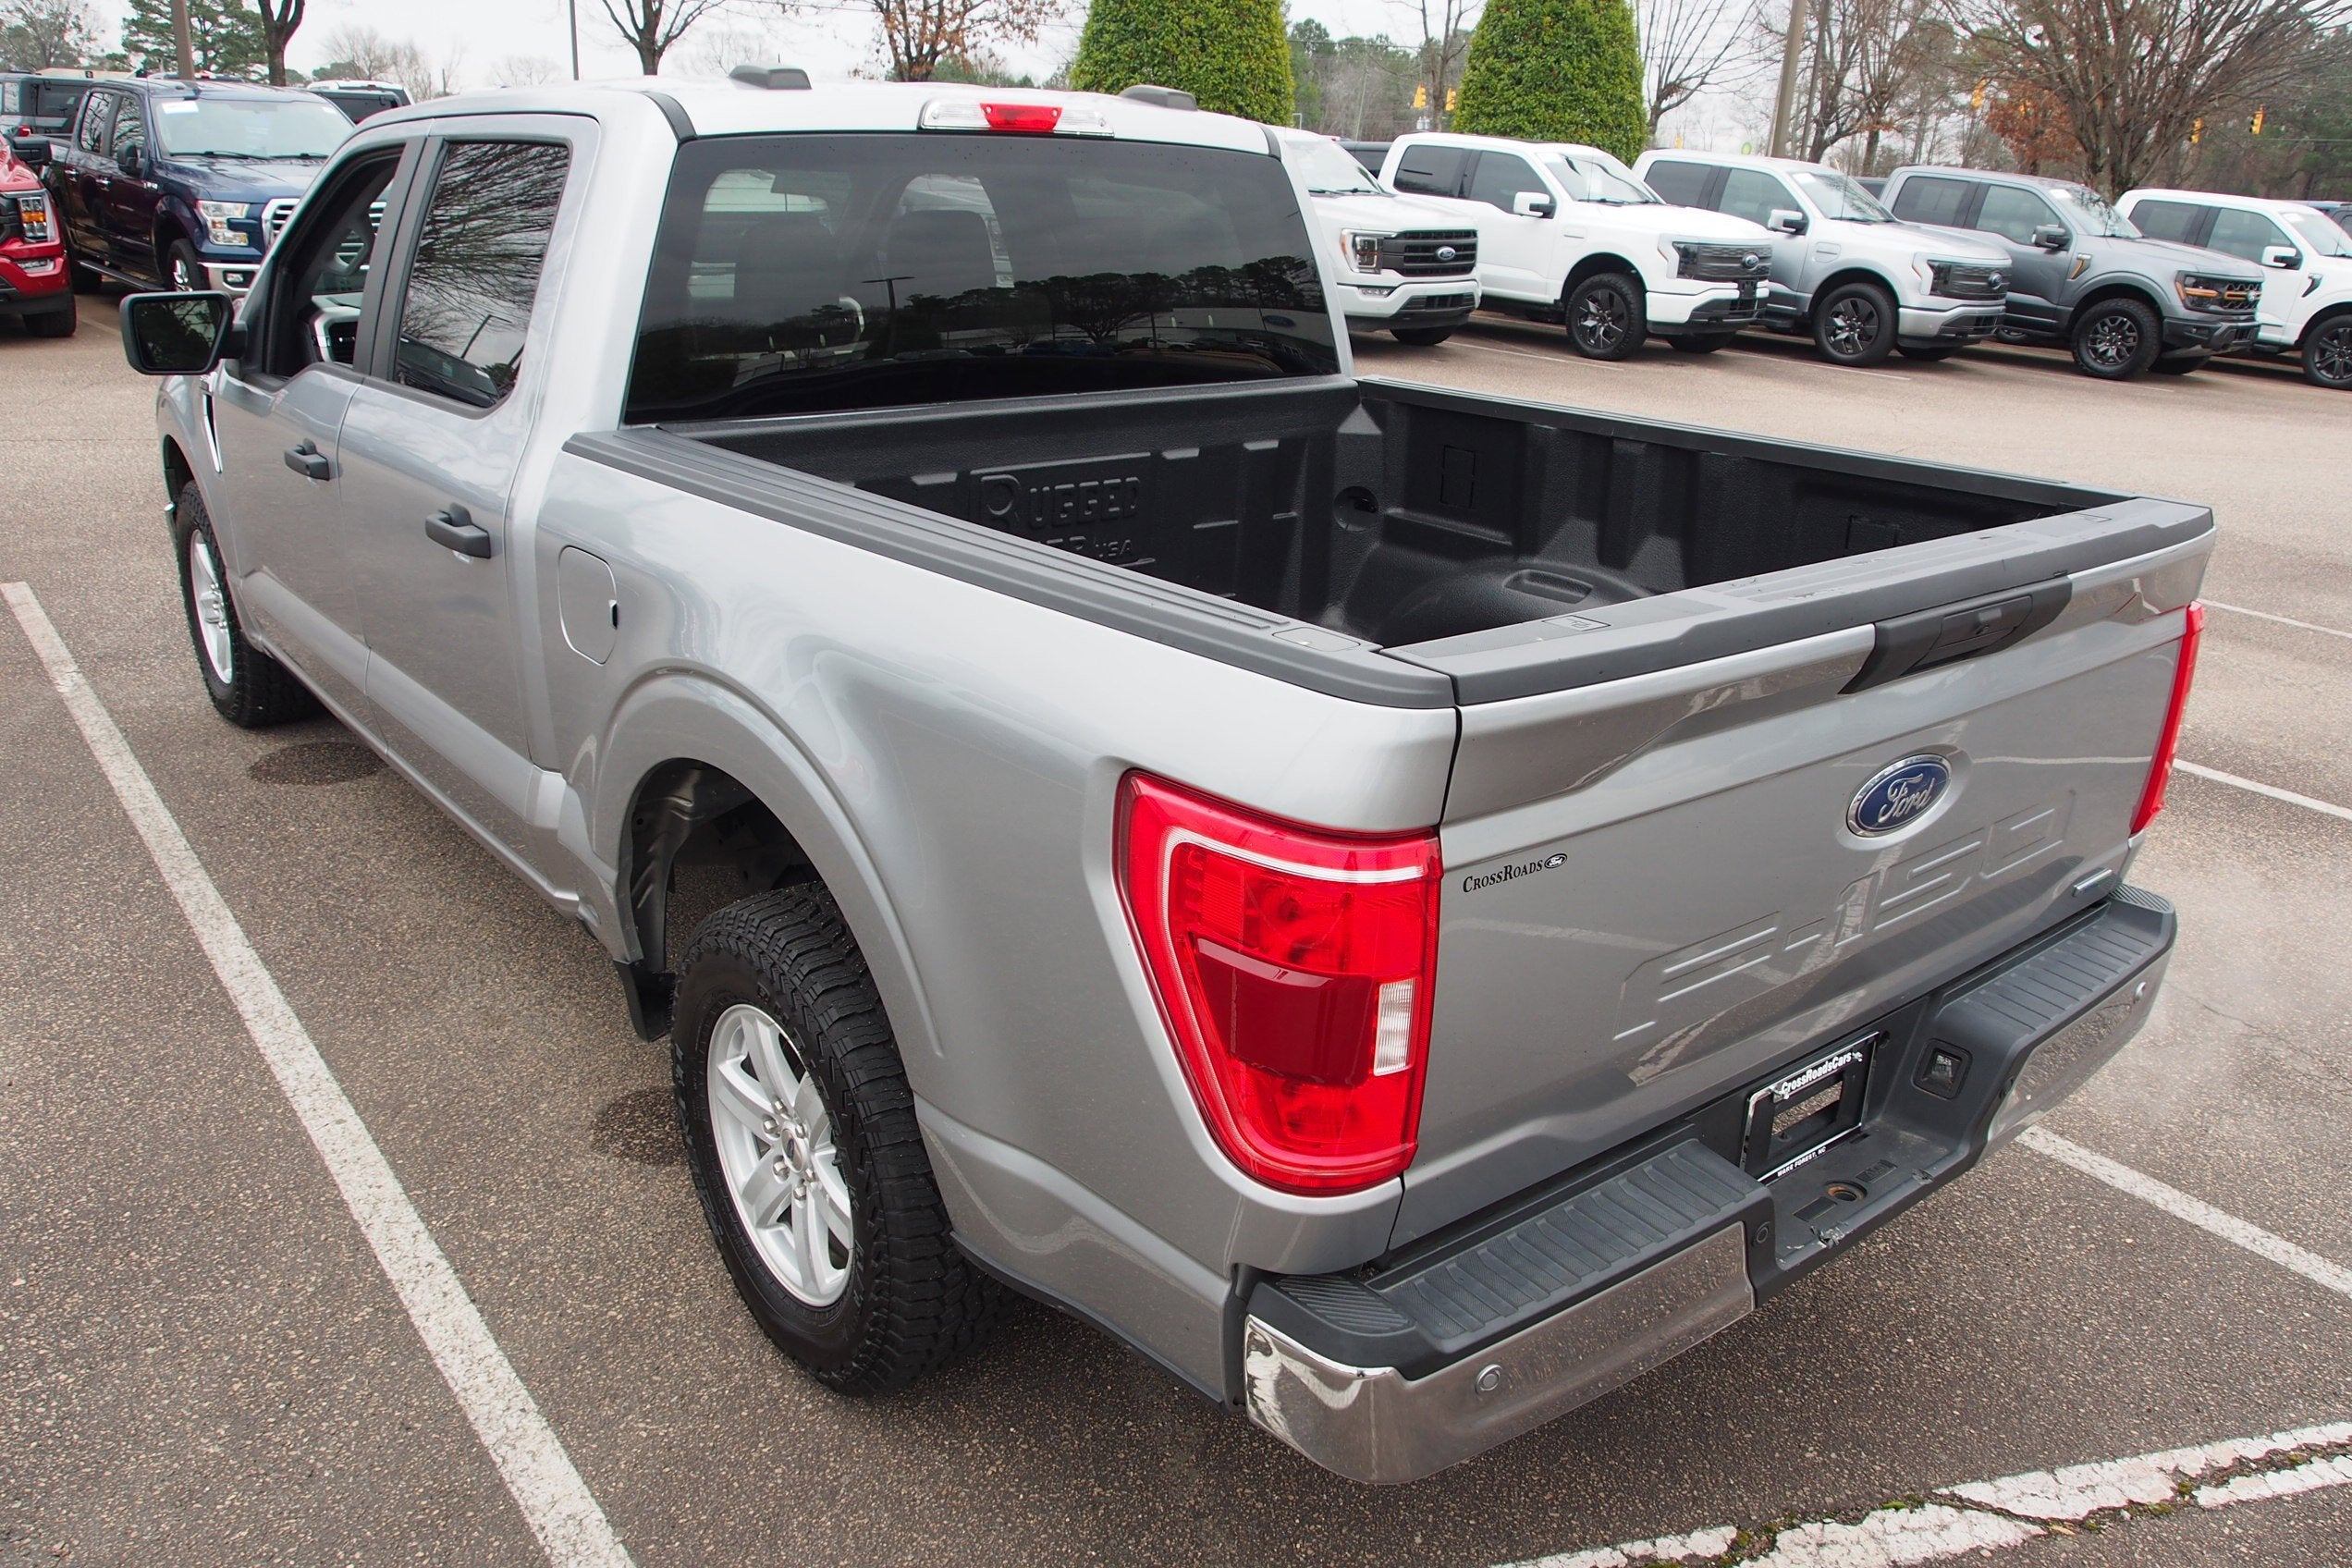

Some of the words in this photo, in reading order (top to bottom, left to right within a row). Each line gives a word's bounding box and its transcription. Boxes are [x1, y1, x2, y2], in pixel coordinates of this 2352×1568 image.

[1878, 773, 1936, 823] Ford
[1612, 790, 2076, 1041] F-150
[1781, 1052, 1852, 1095] CrossRoadsCars
